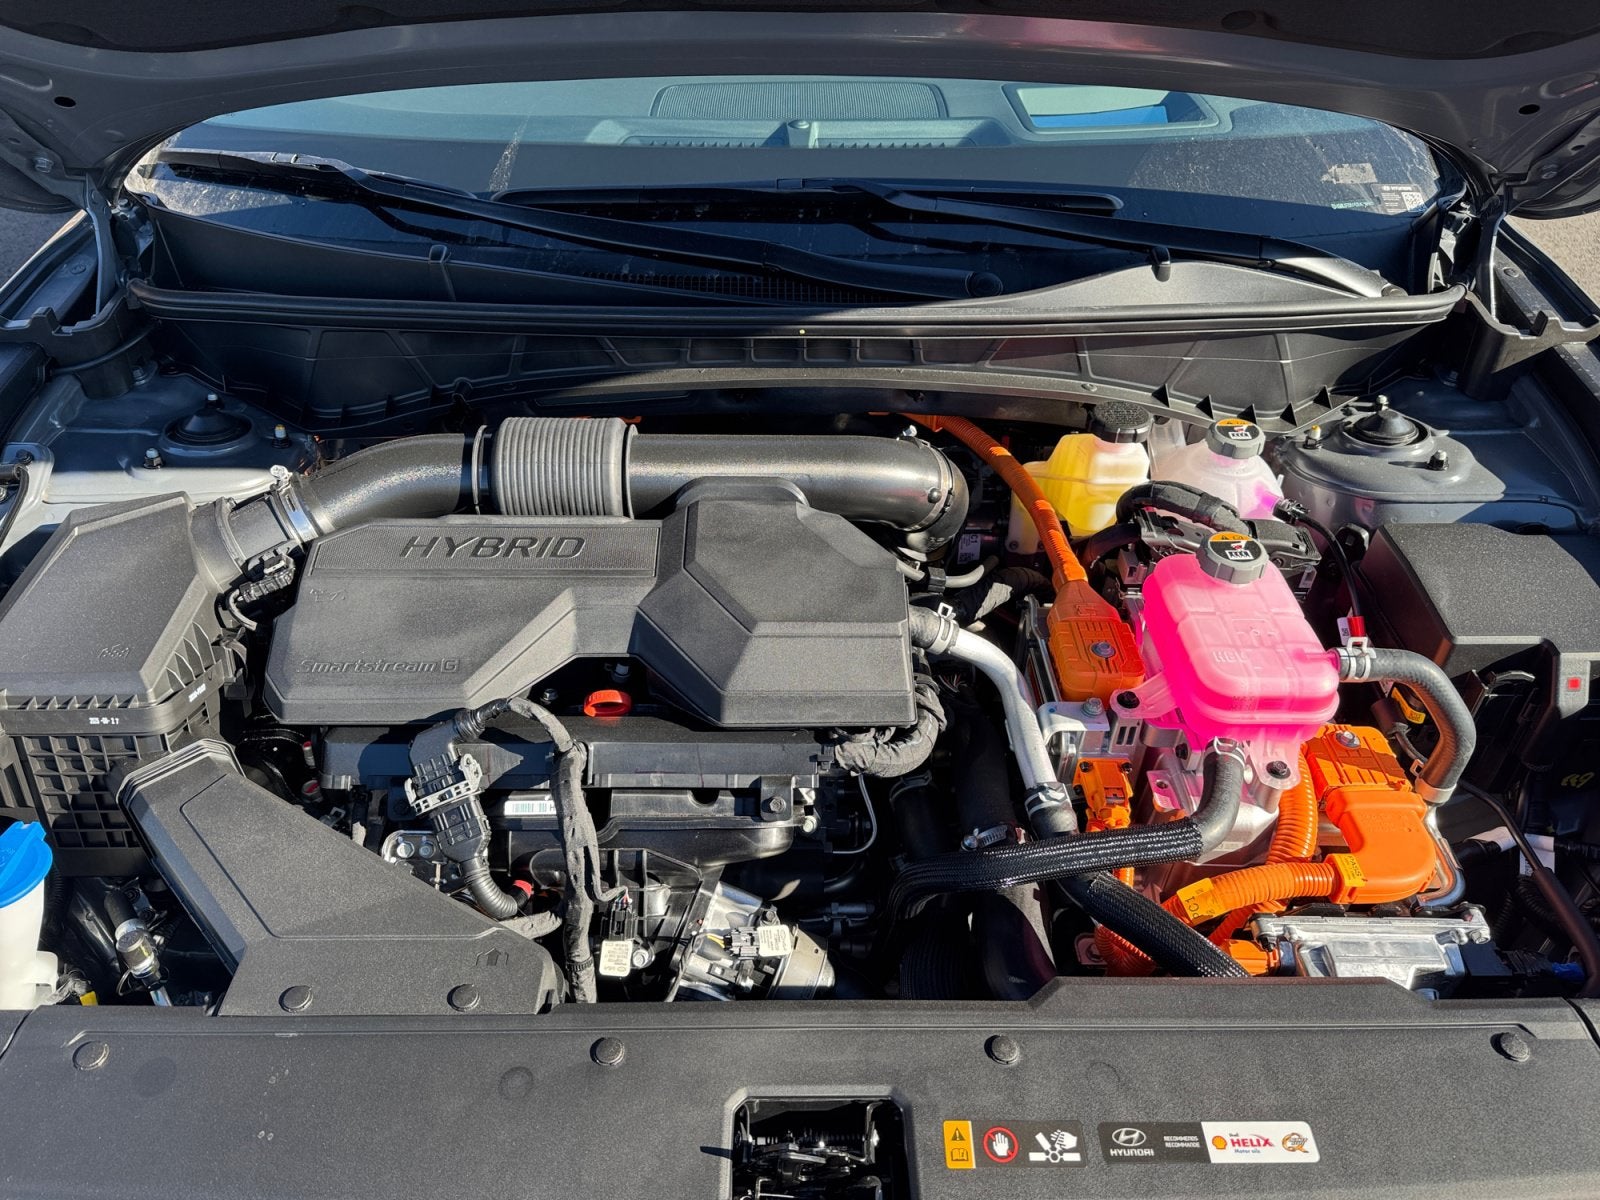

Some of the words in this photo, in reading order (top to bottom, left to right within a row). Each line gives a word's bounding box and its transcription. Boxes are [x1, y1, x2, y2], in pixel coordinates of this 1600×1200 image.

[400, 536, 586, 559] HYBRID
[300, 659, 437, 673] Smartstream
[441, 658, 460, 673] G
[1230, 1138, 1274, 1147] HELIX
